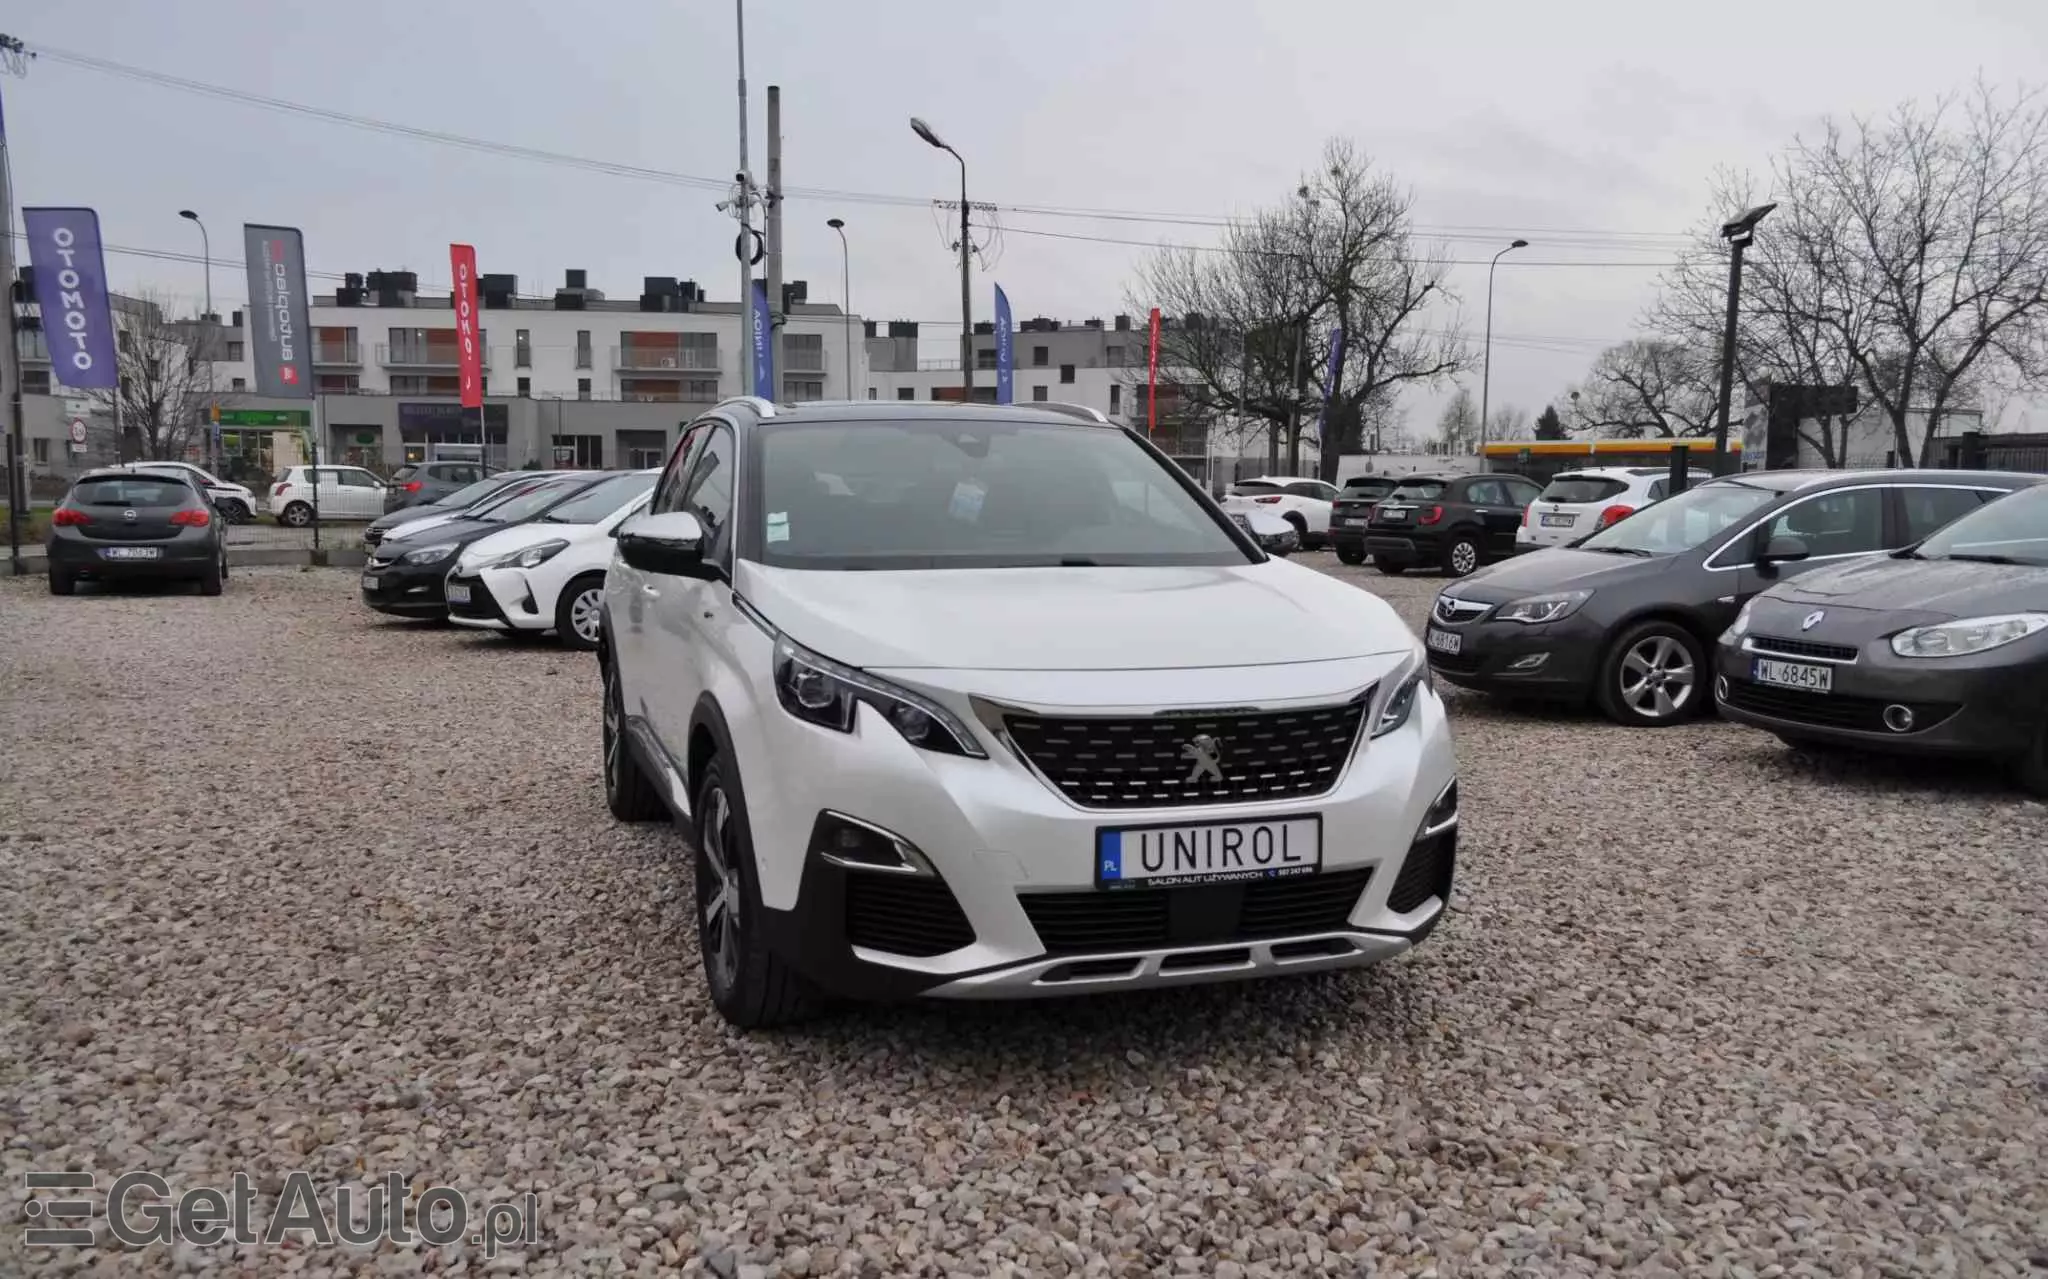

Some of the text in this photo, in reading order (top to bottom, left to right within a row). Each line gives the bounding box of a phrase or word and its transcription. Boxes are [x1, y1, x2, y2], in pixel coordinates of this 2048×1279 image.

[52, 227, 93, 370] OTOMOTO
[1760, 661, 1776, 680] WL
[1782, 664, 1828, 688] 6845W
[1104, 860, 1117, 872] PL
[1141, 824, 1302, 872] UNIROL
